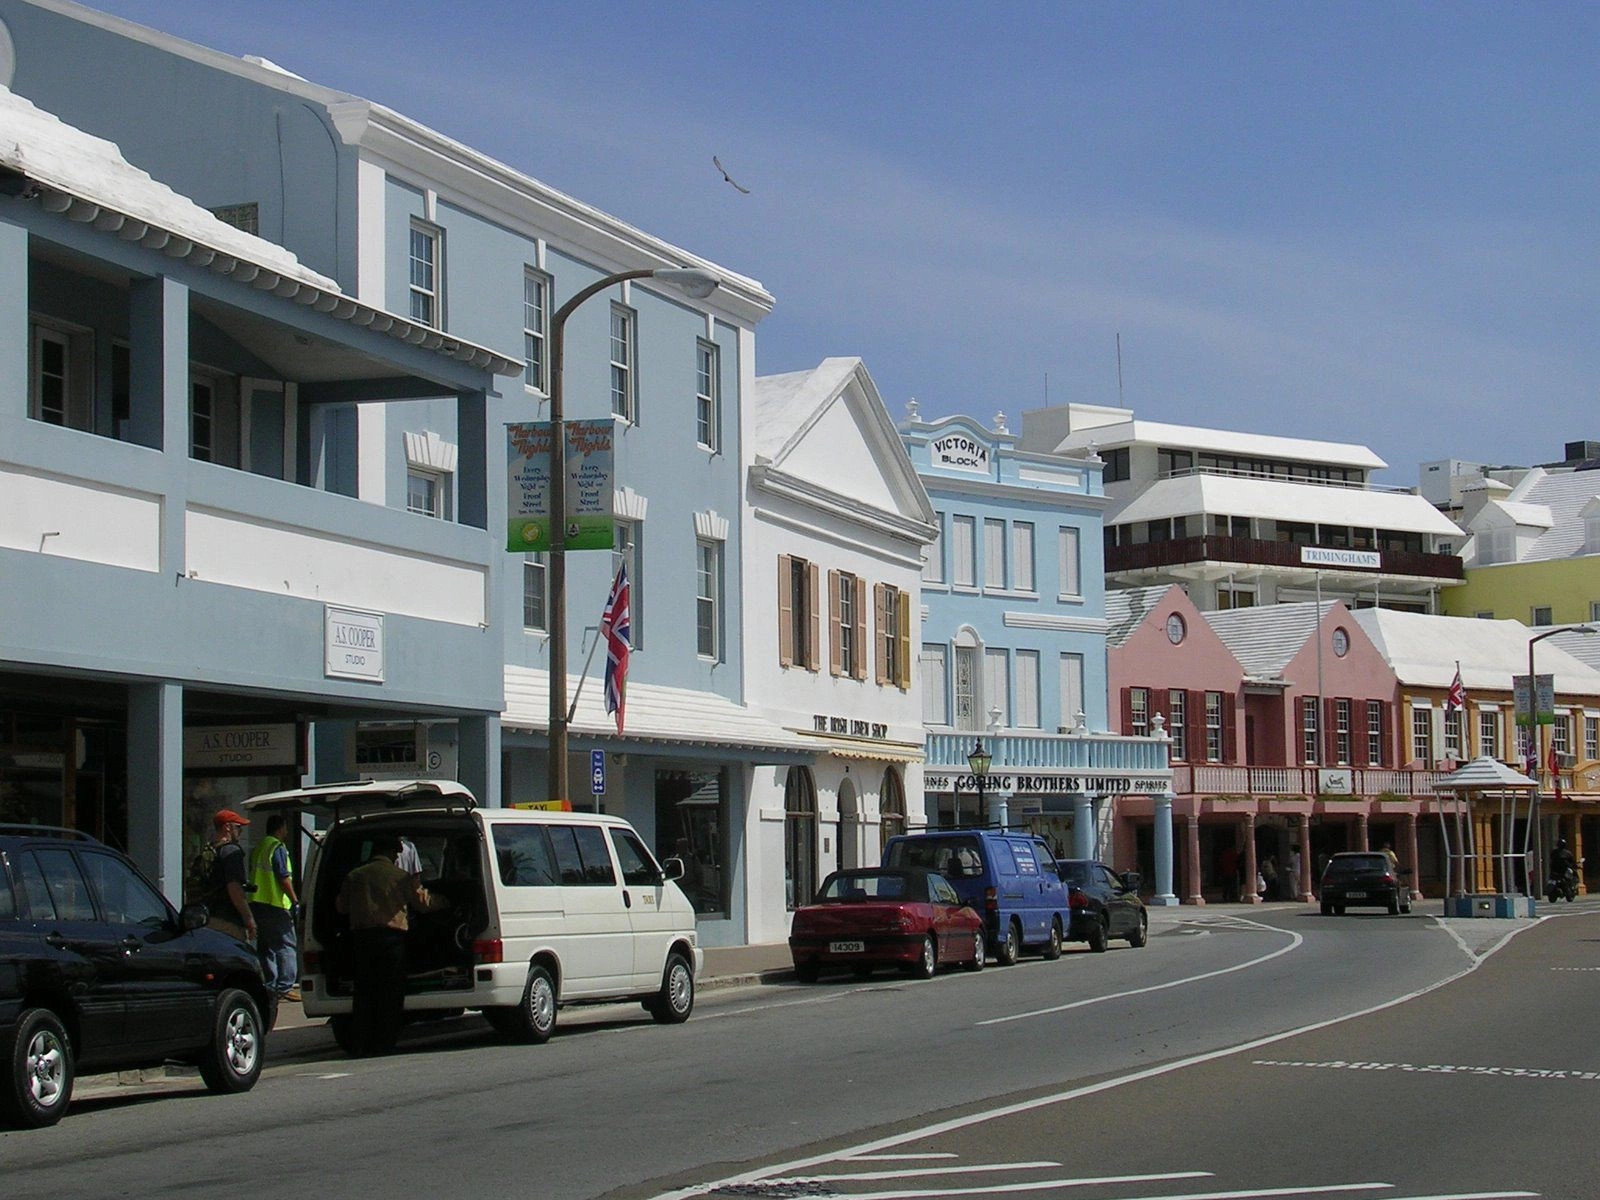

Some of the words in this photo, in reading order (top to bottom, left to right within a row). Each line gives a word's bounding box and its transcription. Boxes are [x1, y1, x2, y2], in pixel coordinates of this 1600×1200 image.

[568, 437, 611, 457] Nights
[934, 438, 986, 462] VICTORIA
[941, 455, 978, 467] BLOCK
[1305, 550, 1377, 565] TRIMINGHAM'S
[349, 627, 375, 648] COOPER
[345, 654, 365, 666] STUDIO
[813, 714, 828, 731] THE
[830, 717, 847, 733] IRISH
[850, 719, 869, 736] LINEN
[872, 722, 888, 739] SHOP
[225, 731, 271, 749] COOPER
[219, 753, 253, 762] STUDIO
[1017, 776, 1080, 791] BROTHERS
[1085, 778, 1131, 791] LIMITED
[1135, 780, 1168, 791] SPIRITS
[642, 895, 655, 904] TAXI
[834, 943, 860, 953] 14309
